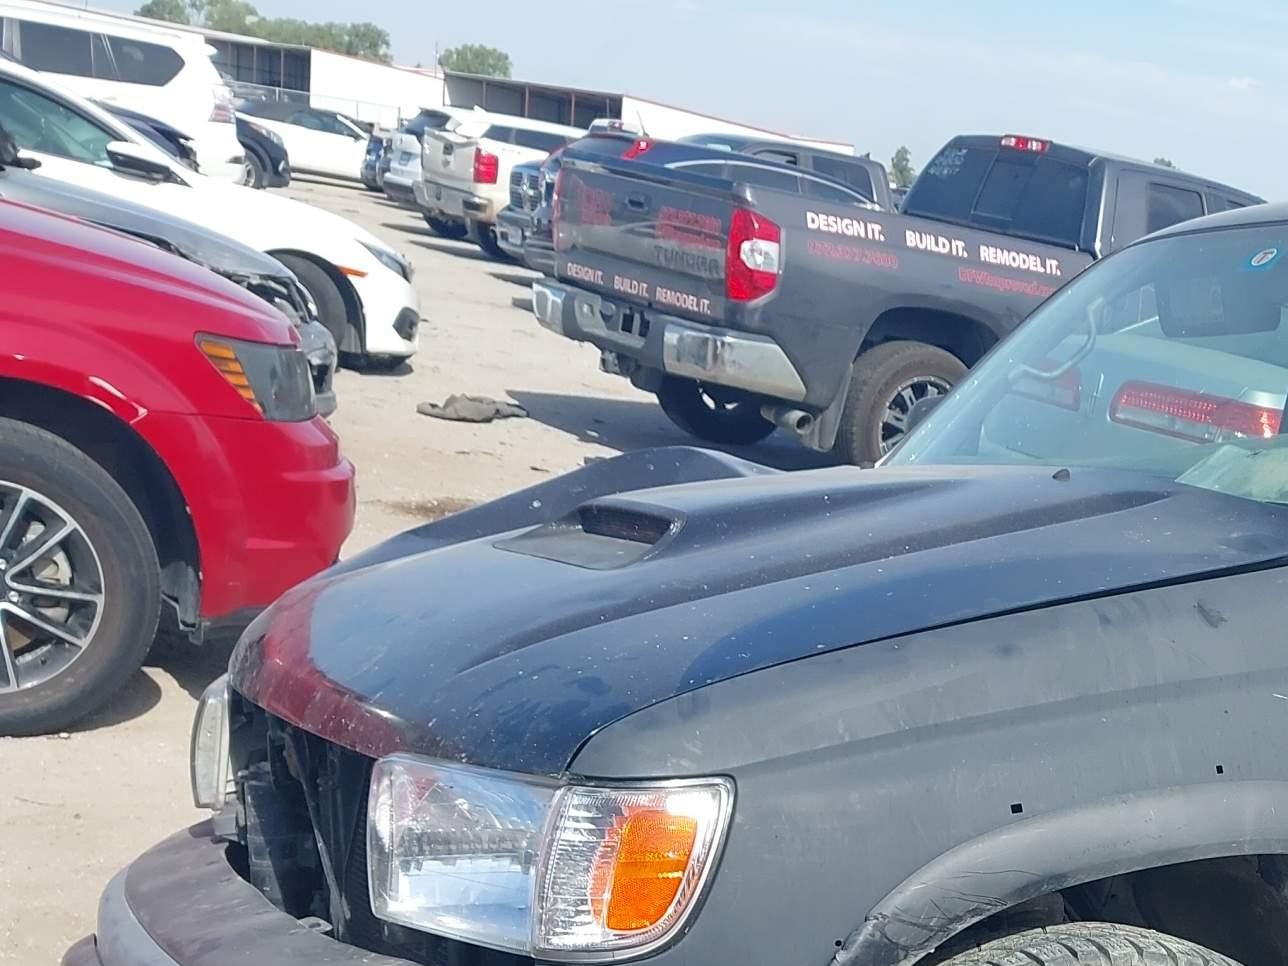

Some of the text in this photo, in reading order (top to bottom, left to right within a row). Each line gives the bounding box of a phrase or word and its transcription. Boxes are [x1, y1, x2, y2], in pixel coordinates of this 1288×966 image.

[806, 211, 866, 239] DESIGN
[866, 222, 885, 242] IT.
[905, 230, 951, 255] BUILD
[951, 239, 968, 258] IT.
[979, 245, 1045, 274] REMODEL
[1045, 258, 1061, 276] IT.
[567, 263, 711, 314] DESIGN IT. BUILD IT. REMODEL IT.
